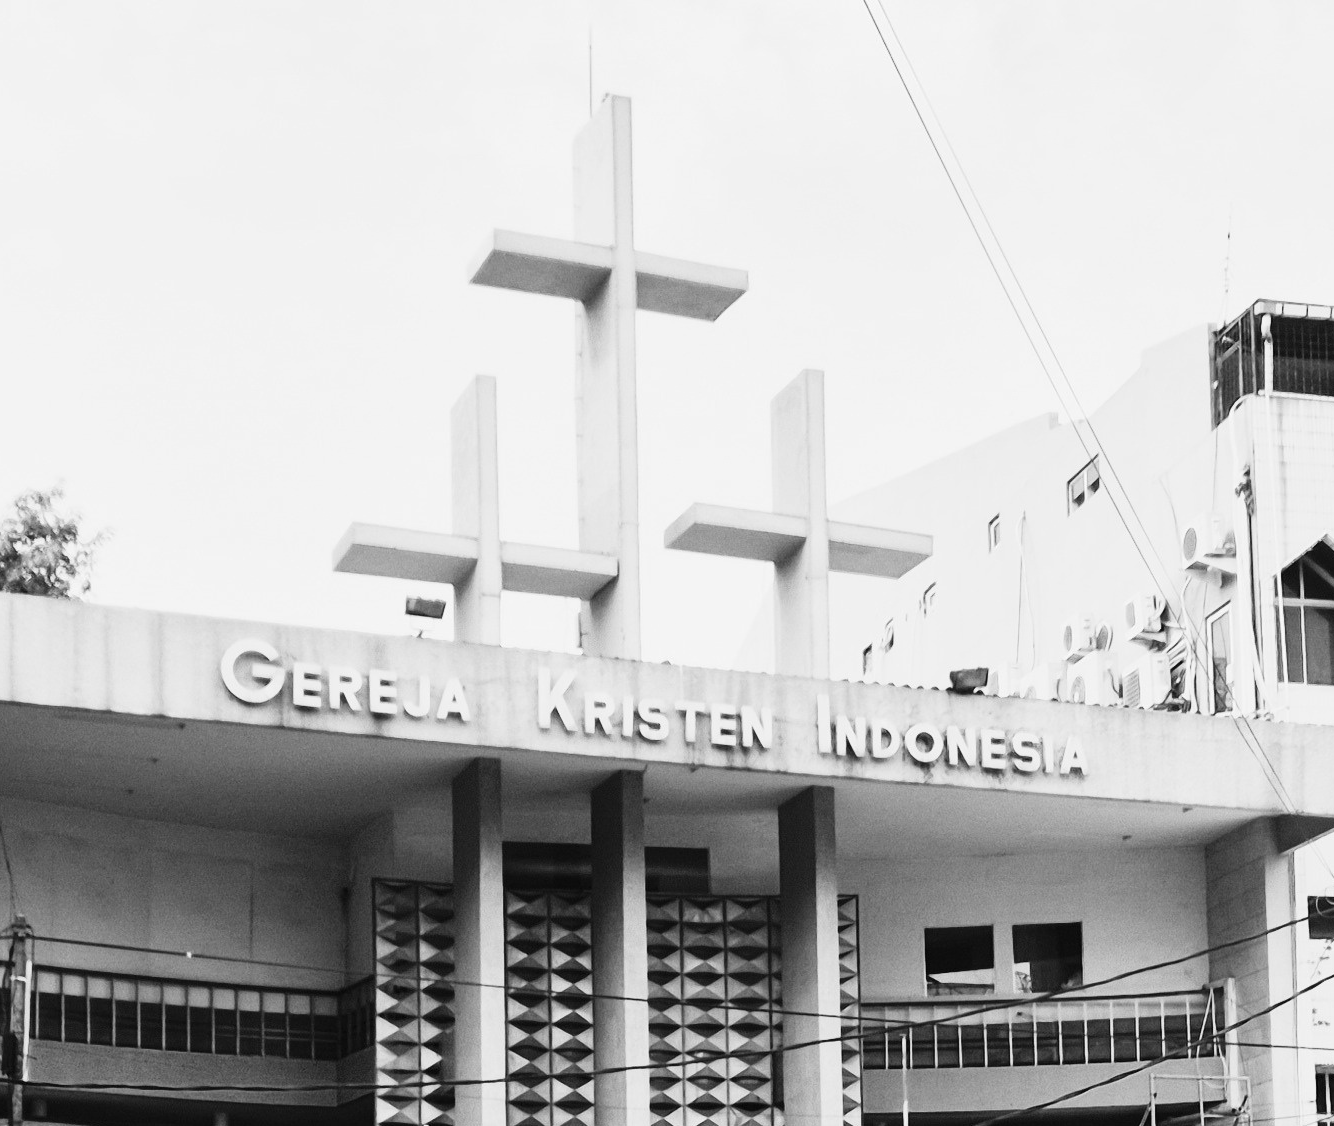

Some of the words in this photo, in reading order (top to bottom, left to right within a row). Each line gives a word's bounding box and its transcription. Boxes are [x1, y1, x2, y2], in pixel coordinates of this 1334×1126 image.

[220, 637, 470, 721] GEREJA
[536, 666, 773, 750] KRISTEN
[817, 694, 1089, 777] INDONESIA
